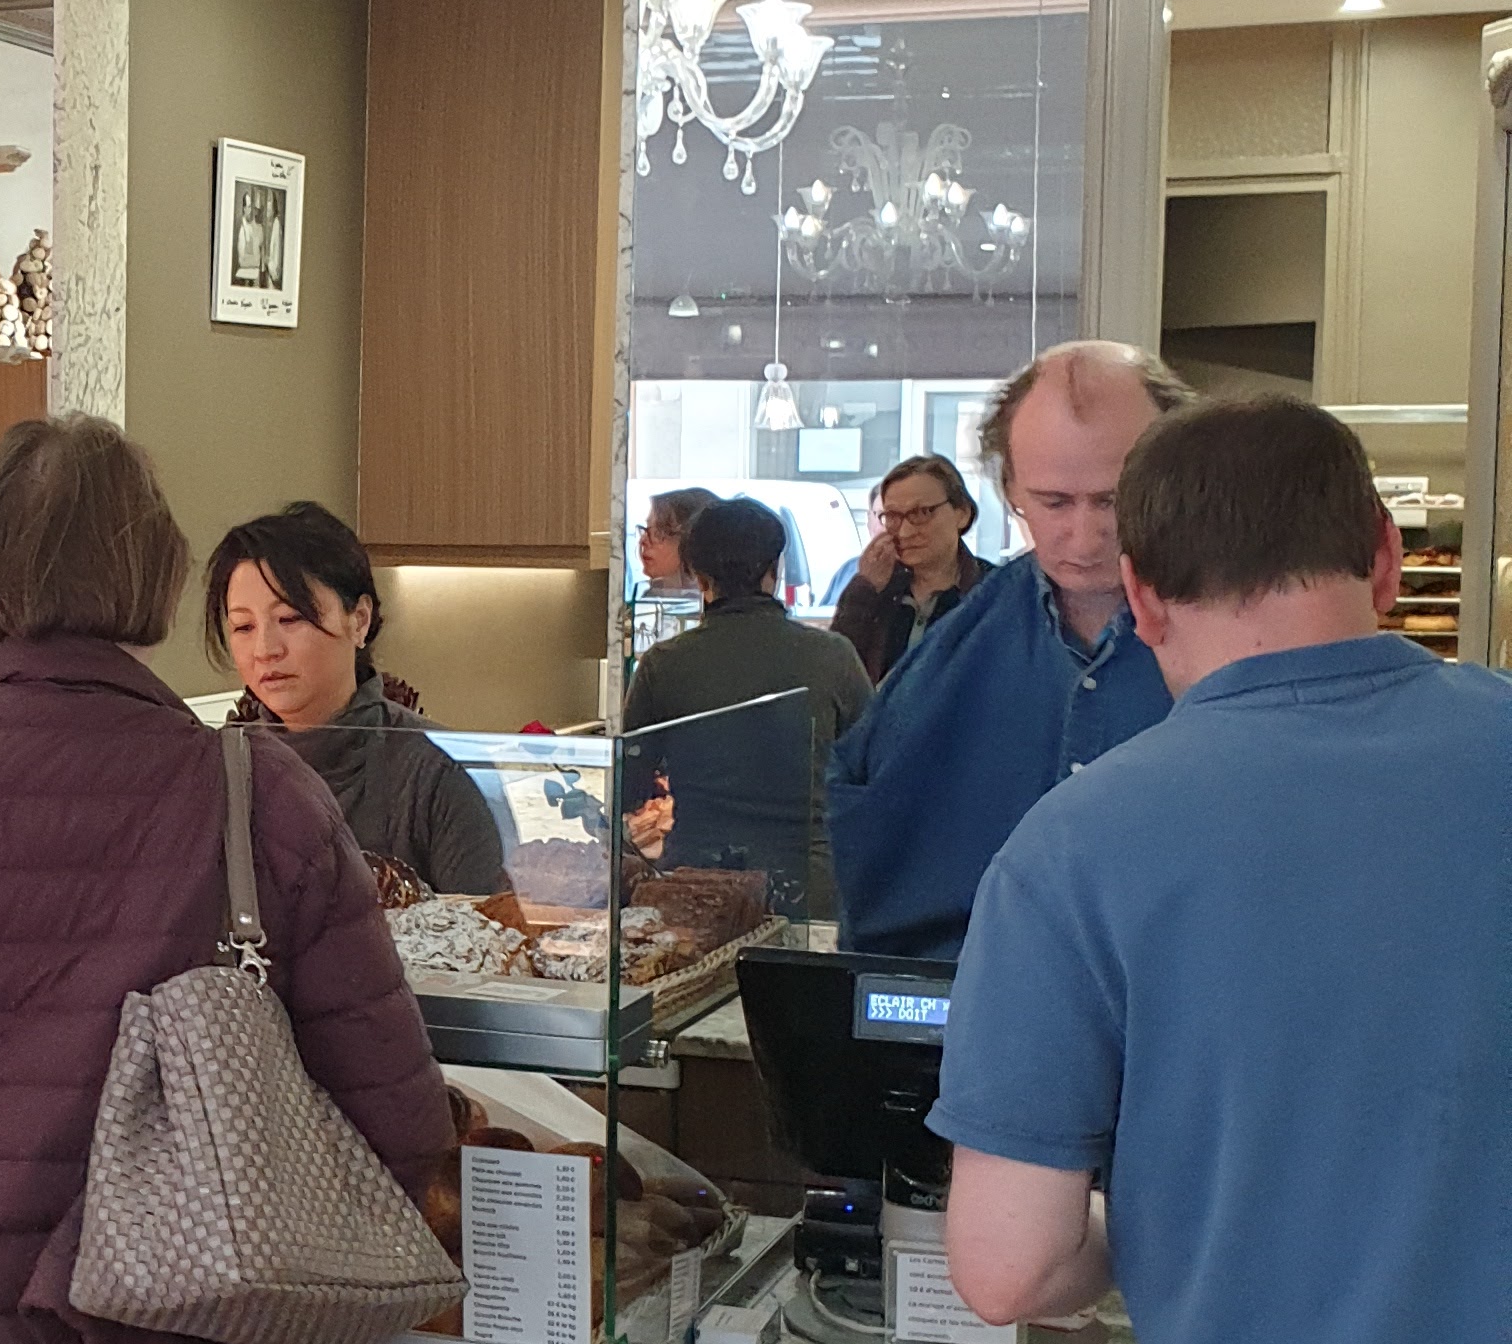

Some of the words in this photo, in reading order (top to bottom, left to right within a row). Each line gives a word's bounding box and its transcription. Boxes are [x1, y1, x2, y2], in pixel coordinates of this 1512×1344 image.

[870, 994, 915, 1010] ECLAIR
[920, 997, 937, 1011] CH
[898, 1008, 928, 1022] DOIT
